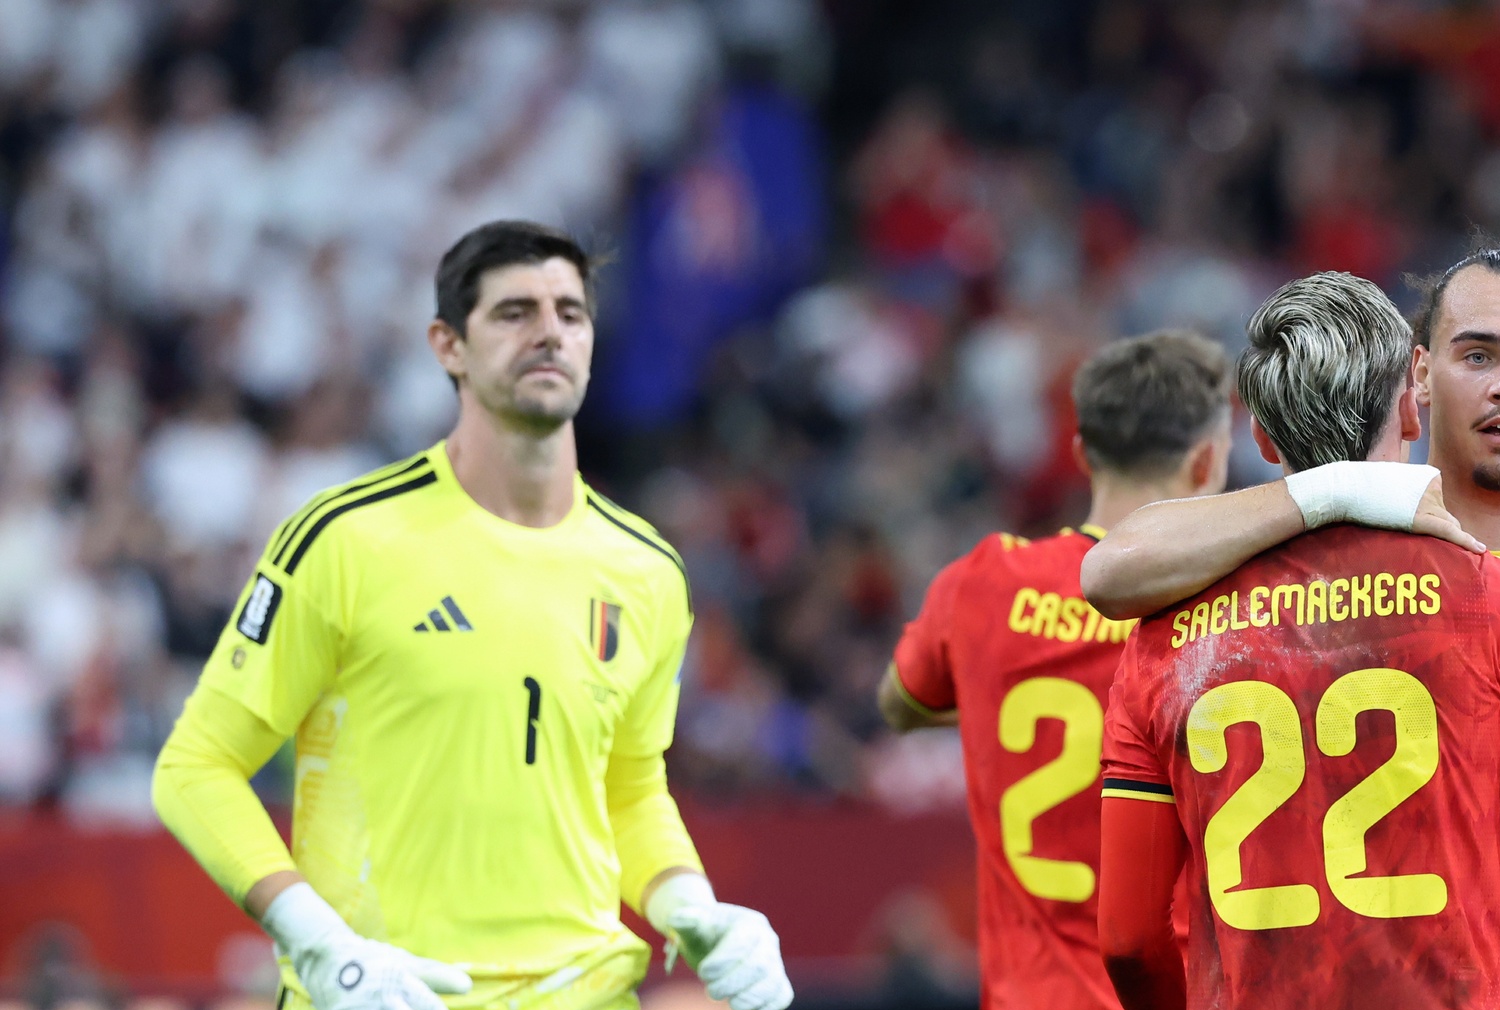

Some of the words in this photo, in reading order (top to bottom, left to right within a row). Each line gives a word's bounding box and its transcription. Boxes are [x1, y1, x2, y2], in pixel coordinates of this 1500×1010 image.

[1170, 572, 1442, 651] SAELEMAEKERS
[523, 675, 541, 765] 1
[1186, 667, 1448, 931] 22
